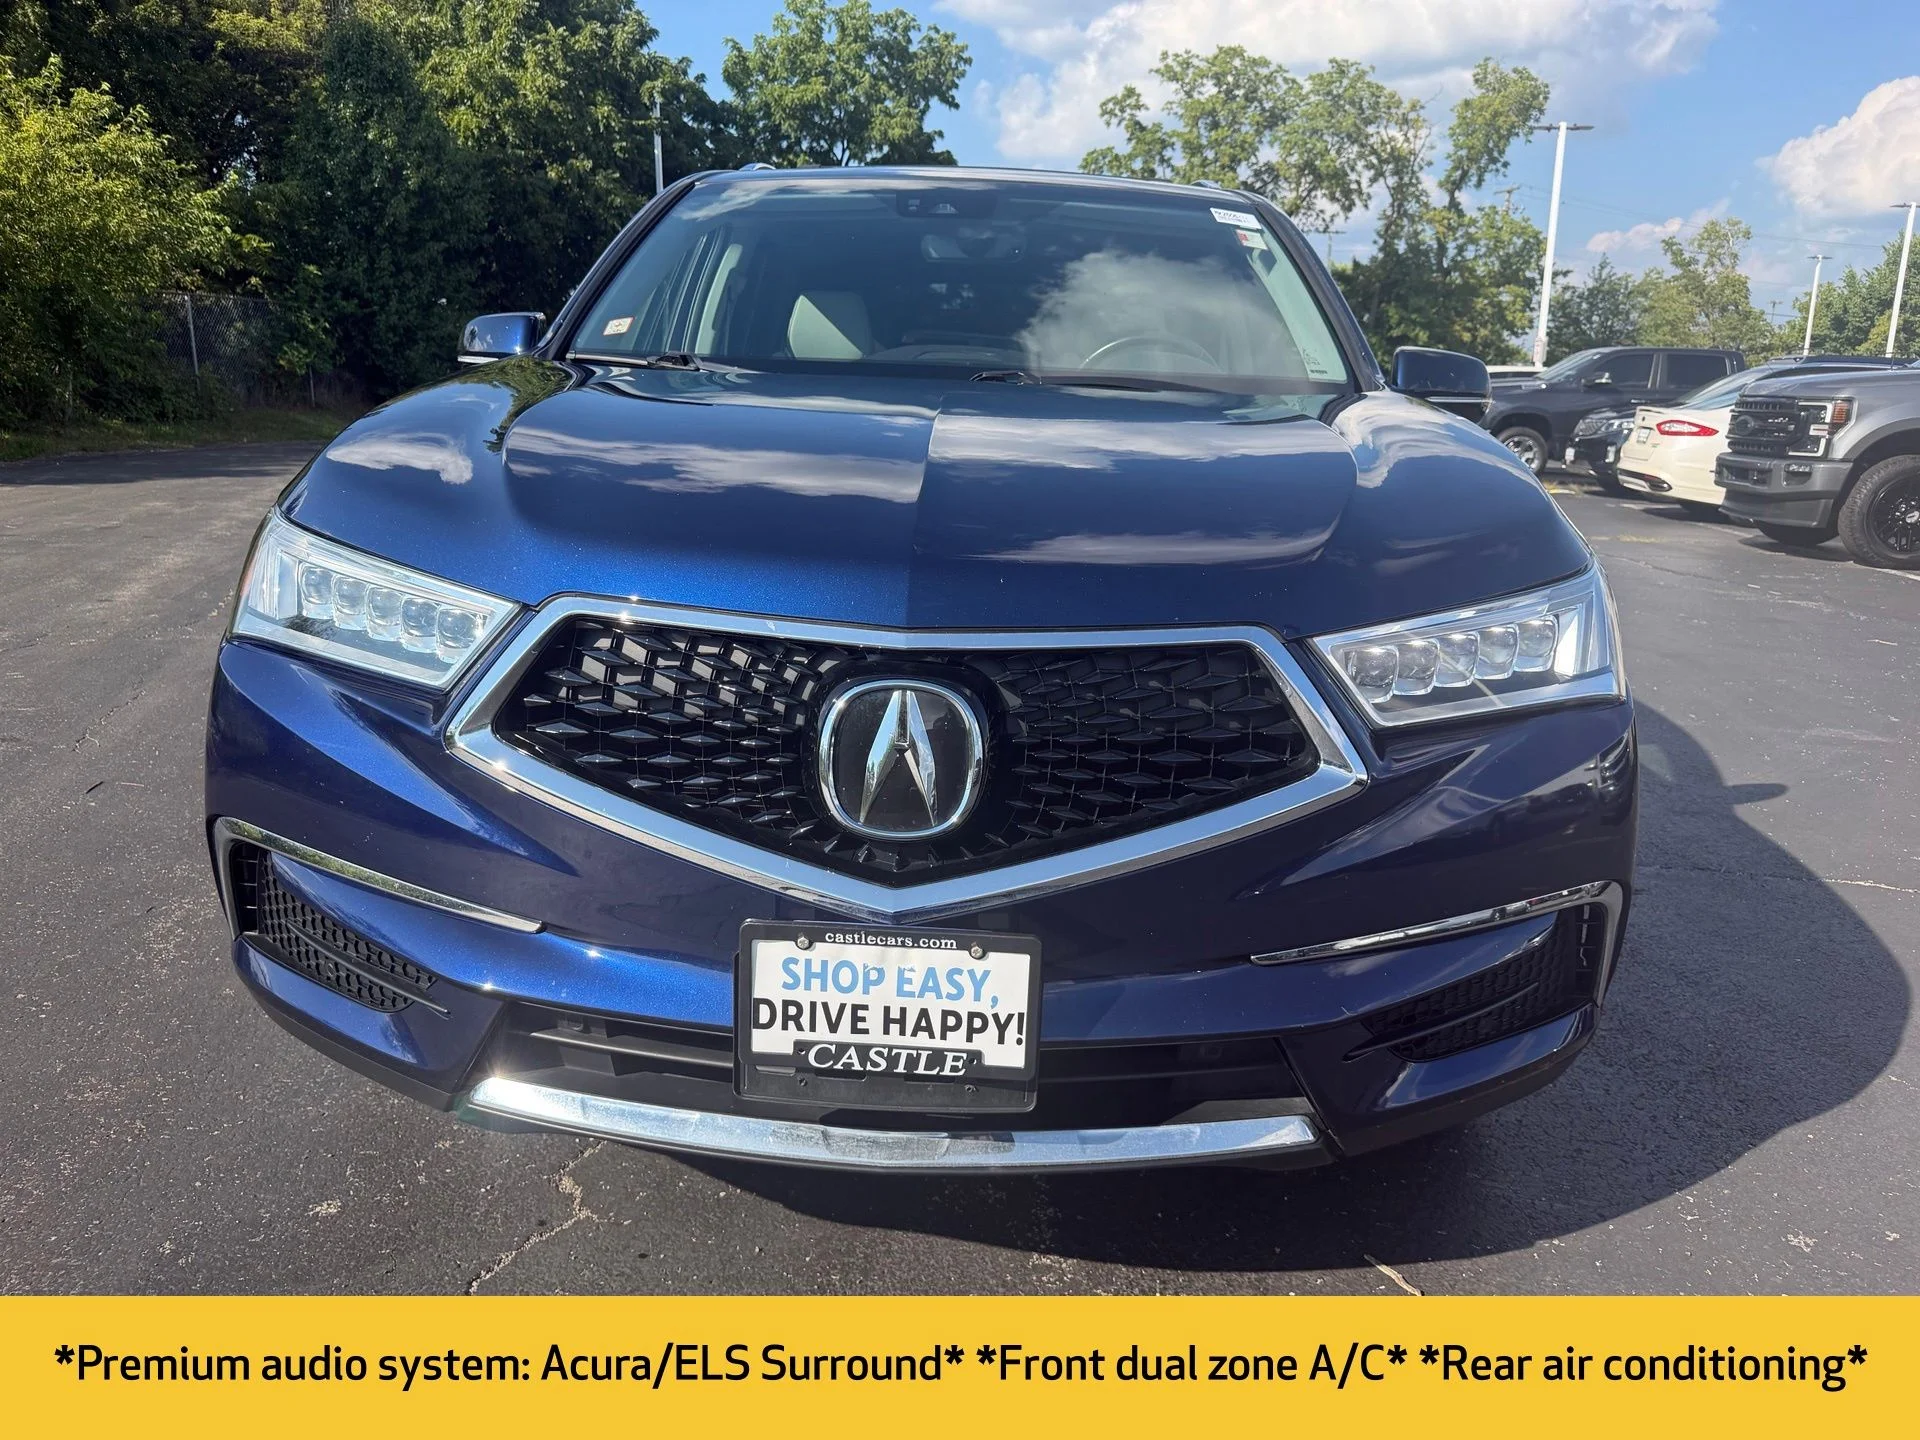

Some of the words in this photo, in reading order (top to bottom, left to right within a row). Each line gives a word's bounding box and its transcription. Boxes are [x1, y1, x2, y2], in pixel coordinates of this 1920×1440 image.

[825, 930, 957, 949] castlecars.com
[781, 956, 886, 995] SHOP
[896, 965, 999, 1010] EASY,
[752, 997, 870, 1035] DRIVE
[882, 1005, 1025, 1046] HAPPY!
[807, 1043, 967, 1077] CASTLE
